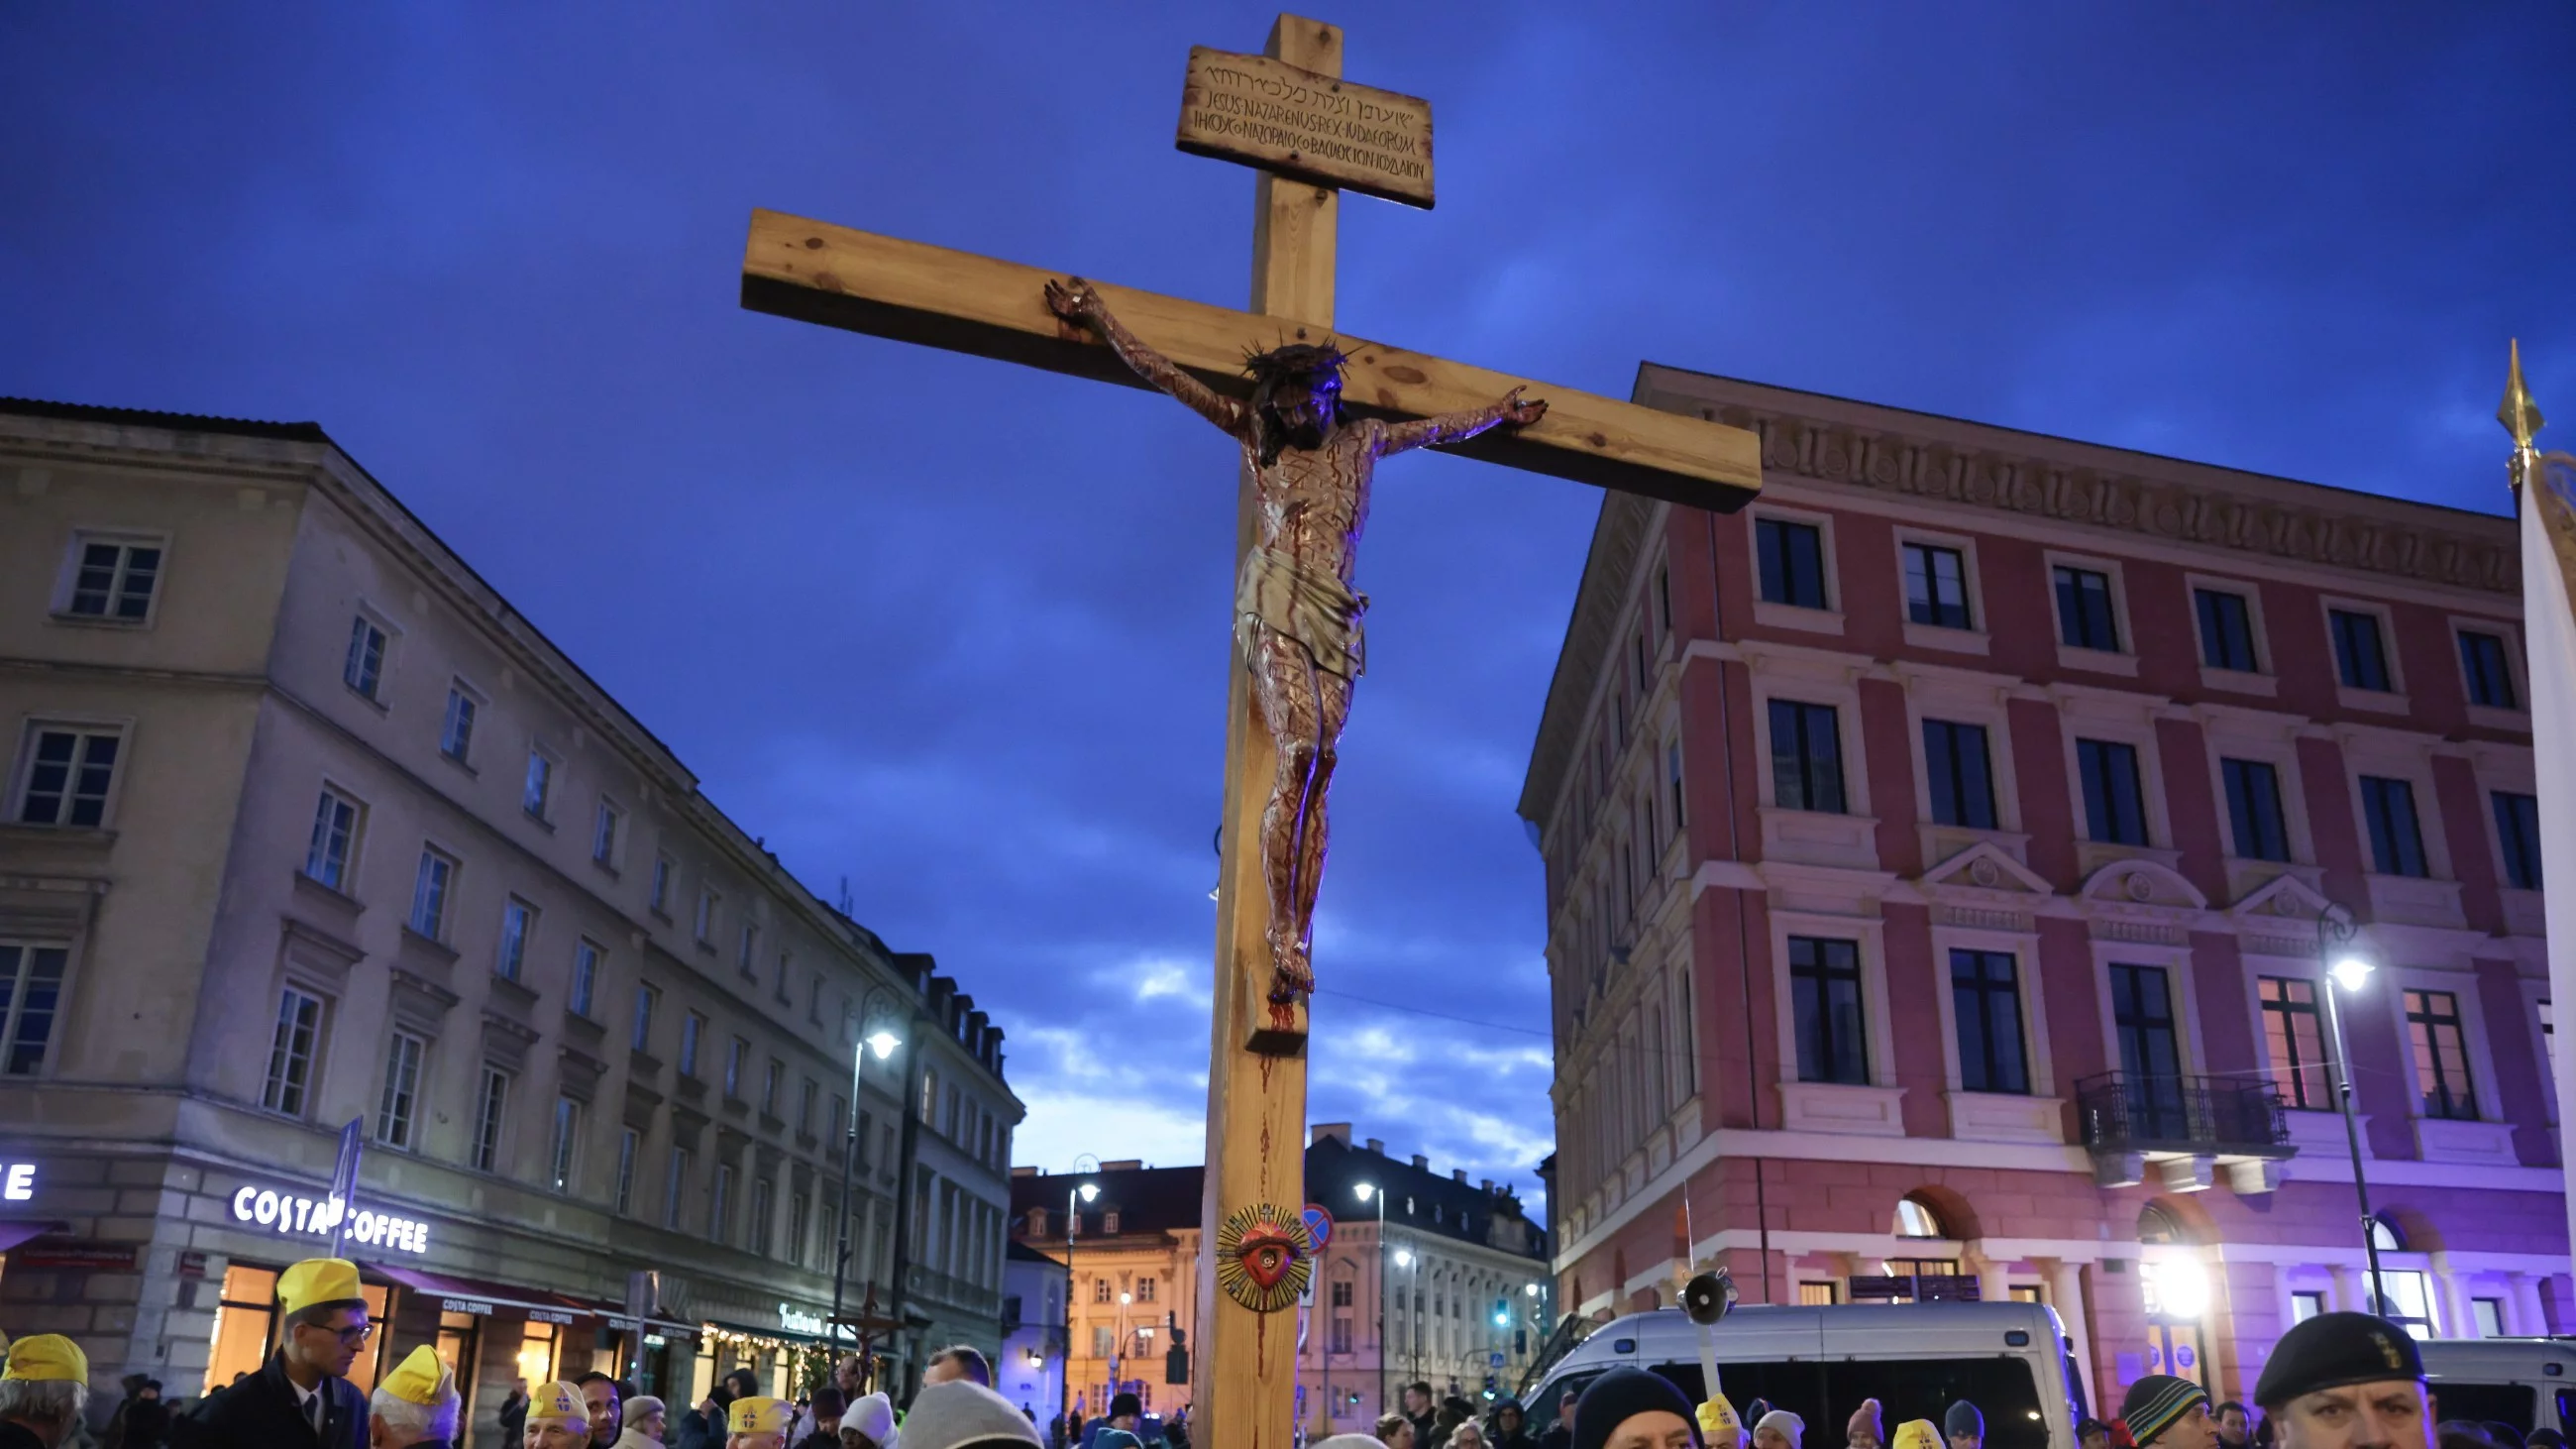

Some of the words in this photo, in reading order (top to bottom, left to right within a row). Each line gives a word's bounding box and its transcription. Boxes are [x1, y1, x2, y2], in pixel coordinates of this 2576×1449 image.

[234, 1186, 328, 1235] COSTA
[443, 1299, 467, 1312] COSTA
[468, 1302, 492, 1315] COFFEE
